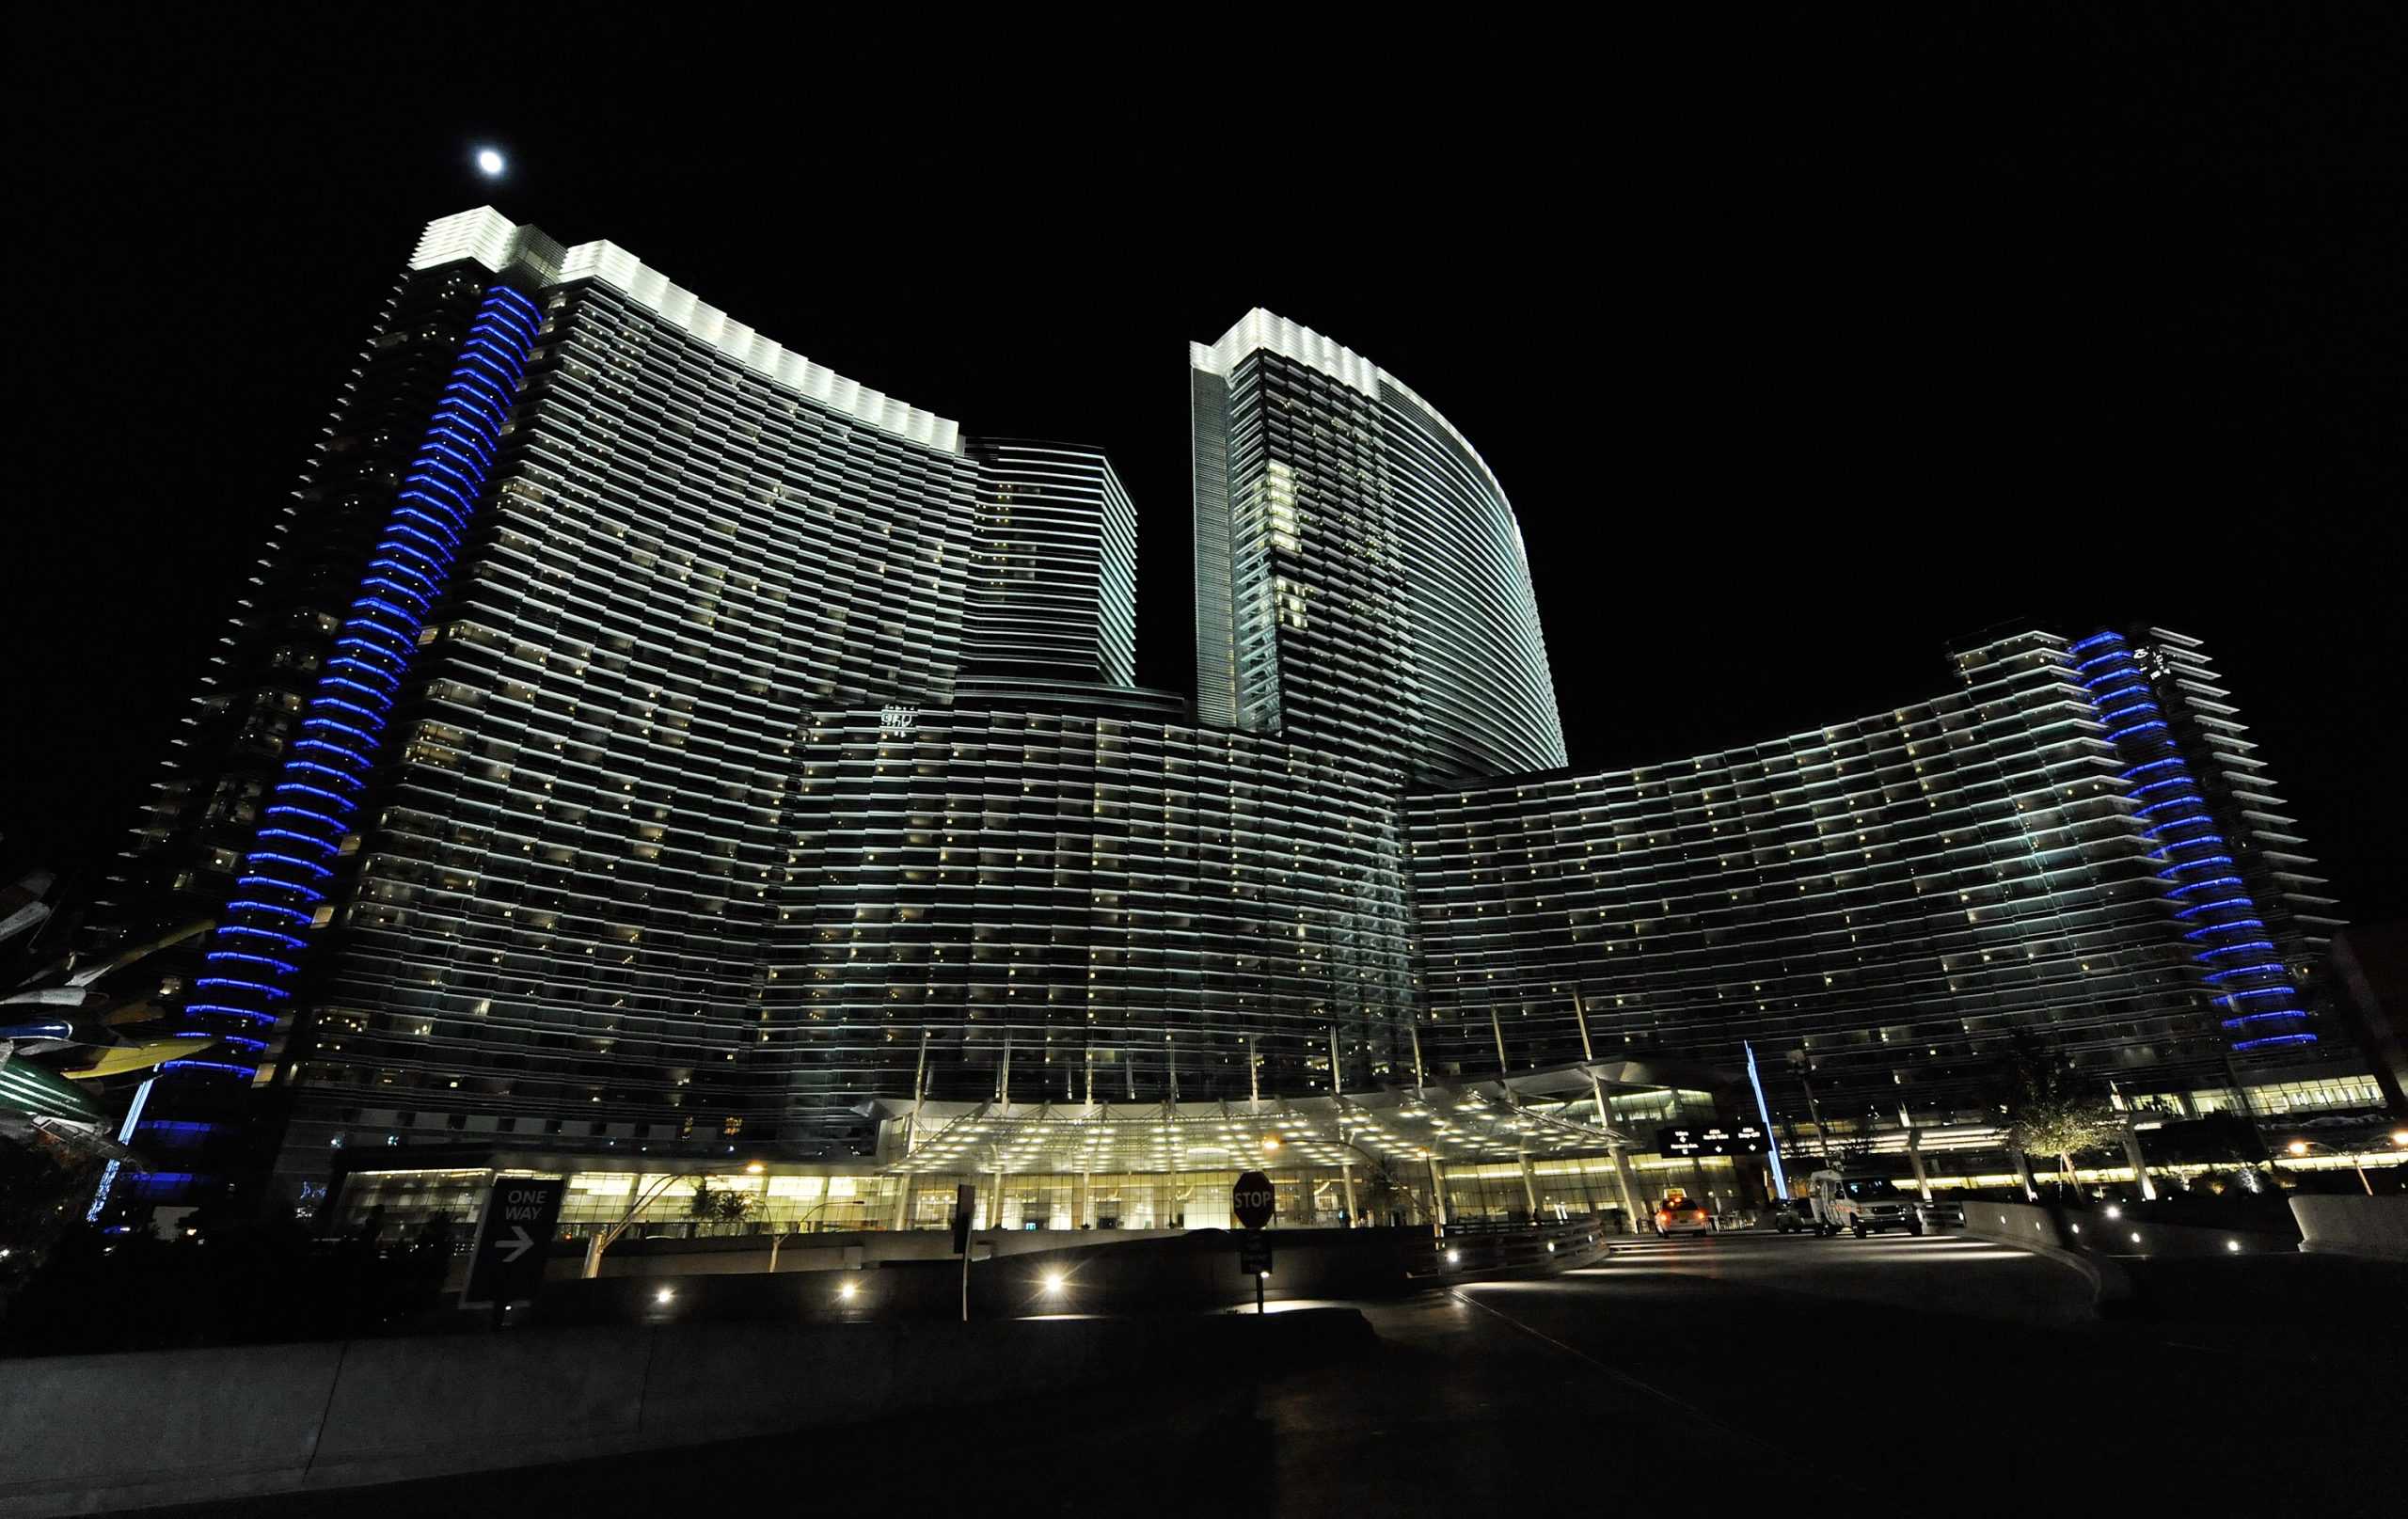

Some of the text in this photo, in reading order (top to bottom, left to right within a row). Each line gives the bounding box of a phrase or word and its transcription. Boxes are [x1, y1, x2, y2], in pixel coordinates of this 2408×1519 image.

[508, 1190, 548, 1204] ONE
[1234, 1191, 1272, 1209] STOP
[505, 1206, 543, 1220] WAY
